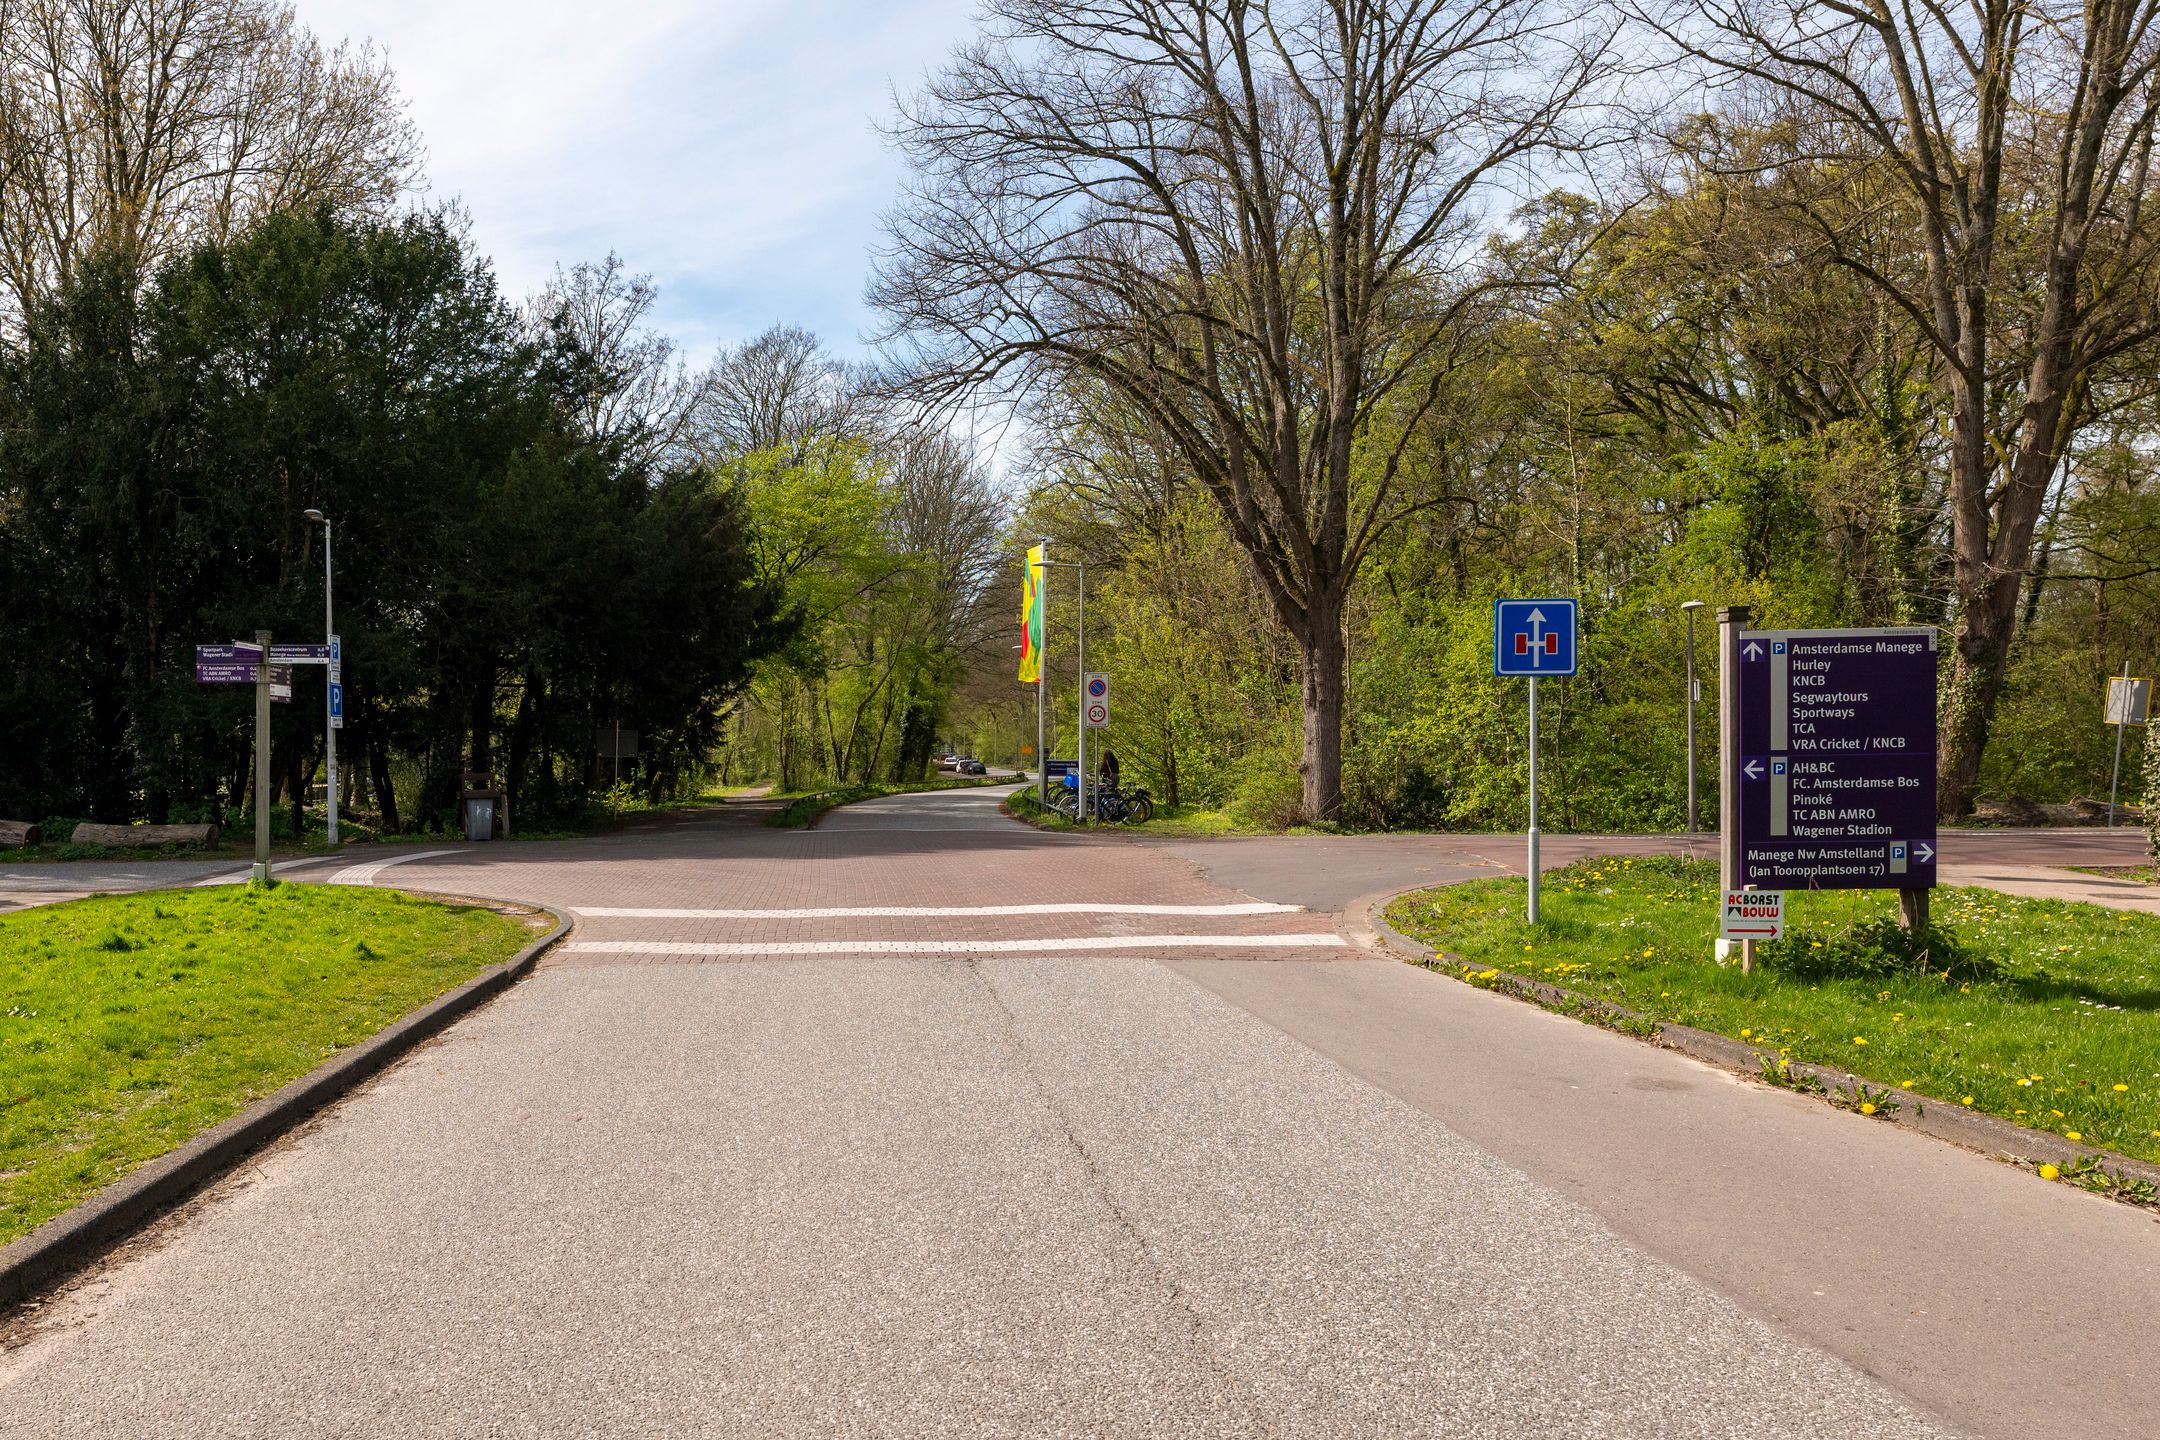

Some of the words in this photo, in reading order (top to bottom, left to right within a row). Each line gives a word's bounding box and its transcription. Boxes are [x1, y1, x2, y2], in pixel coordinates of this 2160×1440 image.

[1775, 644, 1783, 653] P
[1792, 643, 1872, 655] Amsterdamse
[1875, 642, 1922, 655] Manege
[1793, 660, 1831, 673] Hurley
[1793, 676, 1826, 687] KNCB
[334, 688, 340, 712] P
[1793, 692, 1868, 705] Segwaytours
[1793, 708, 1855, 720] Sportways
[1793, 723, 1816, 734] TCA
[1793, 739, 1817, 750] VRA
[1820, 738, 1860, 750] Cricket
[1864, 737, 1869, 750] /
[1873, 737, 1906, 748] KNCB
[1775, 764, 1784, 774] P
[1793, 762, 1835, 773] AH&BC
[1793, 779, 1810, 789] FC.
[1813, 777, 1894, 788] Amsterdamse
[1898, 776, 1920, 787] Bos
[1793, 794, 1833, 805] Pinoké
[1793, 810, 1807, 820] TC
[1810, 809, 1835, 820] ABN
[1838, 809, 1876, 819] AMRO
[1793, 825, 1845, 838] Wagener
[1847, 824, 1892, 835] Stadion
[1748, 850, 1794, 862] Manege
[1797, 849, 1817, 859] Nw
[1819, 847, 1885, 859] Amstelland
[1894, 848, 1902, 856] P
[1749, 866, 1771, 877] (Jan
[1773, 864, 1866, 878] Tooropplantsoen
[1869, 863, 1885, 876] 17)
[1743, 907, 1779, 917] BOUW
